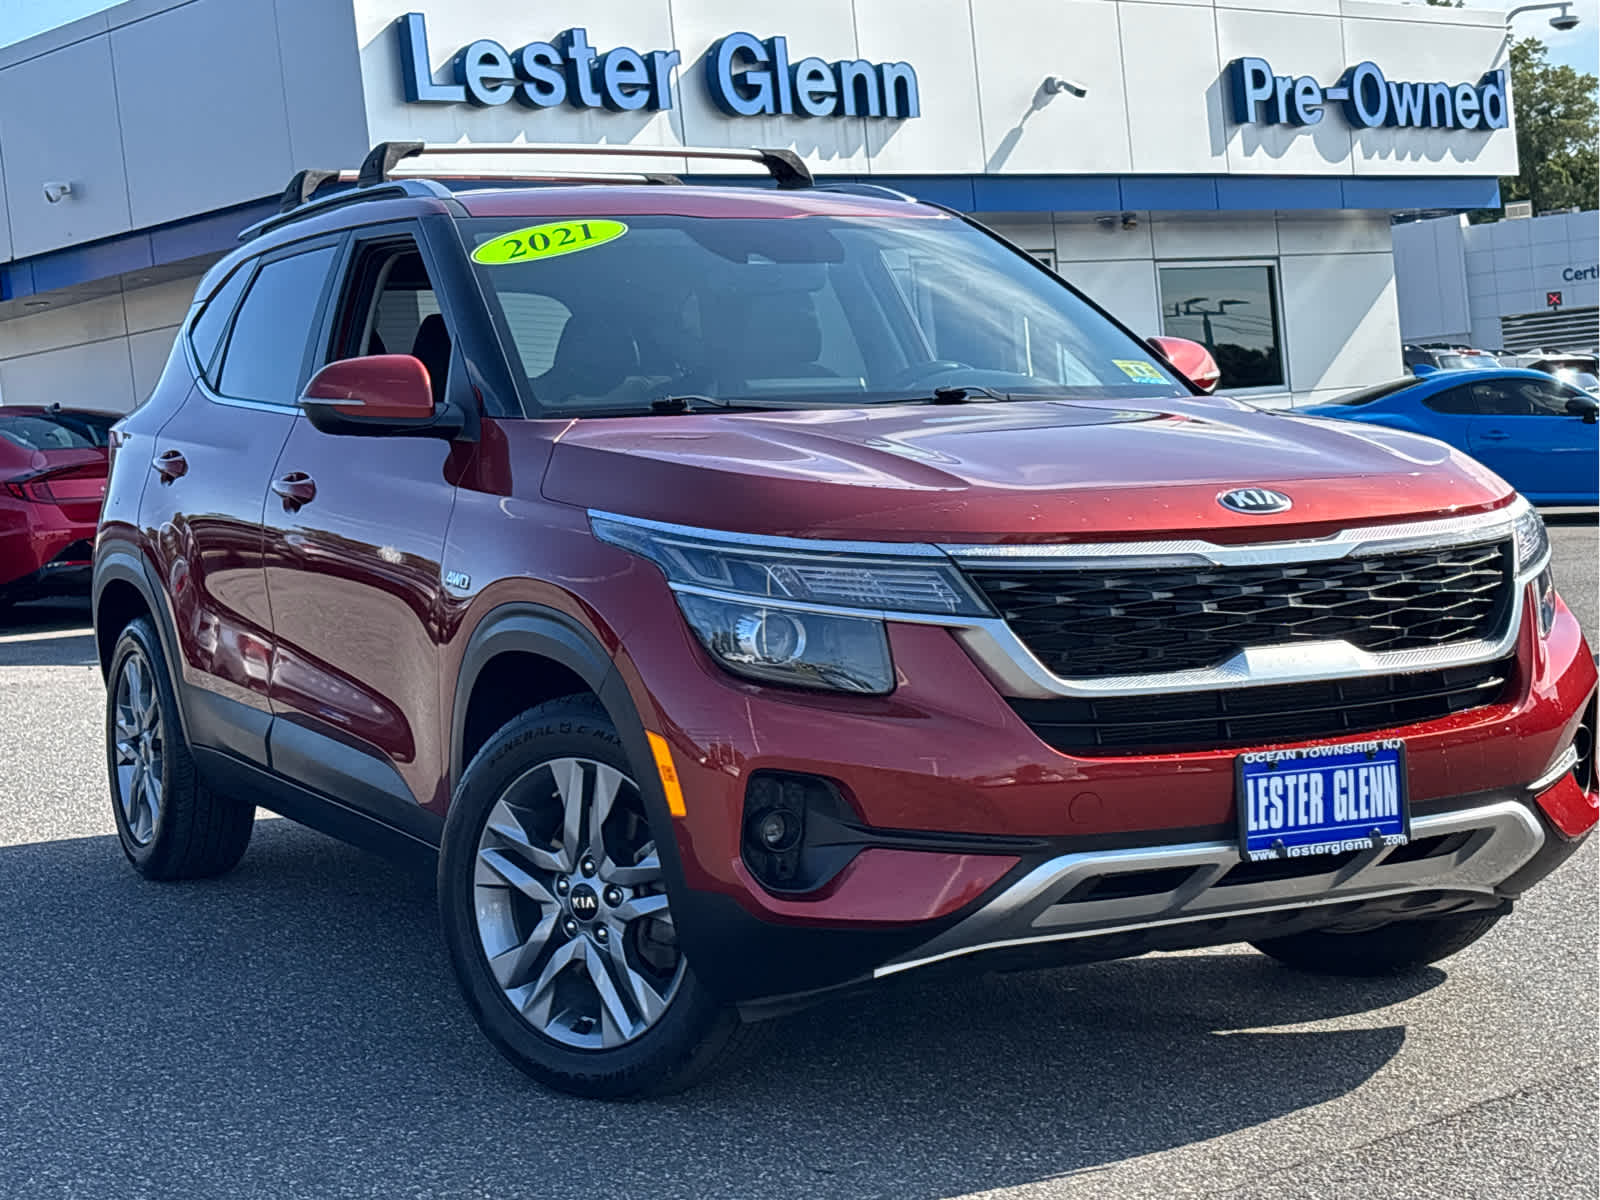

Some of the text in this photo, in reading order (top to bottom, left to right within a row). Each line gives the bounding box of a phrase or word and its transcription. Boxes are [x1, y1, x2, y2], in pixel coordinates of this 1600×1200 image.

[402, 12, 920, 119] Lester Glenn
[1229, 57, 1509, 129] Pre-Owned
[503, 223, 599, 259] 2021
[1230, 490, 1287, 507] KIA
[446, 570, 471, 590] AWD
[1243, 740, 1401, 764] OCEAN TOWNSHIP NJ
[1246, 764, 1399, 832] LESTER GLENN
[571, 896, 596, 909] KIA
